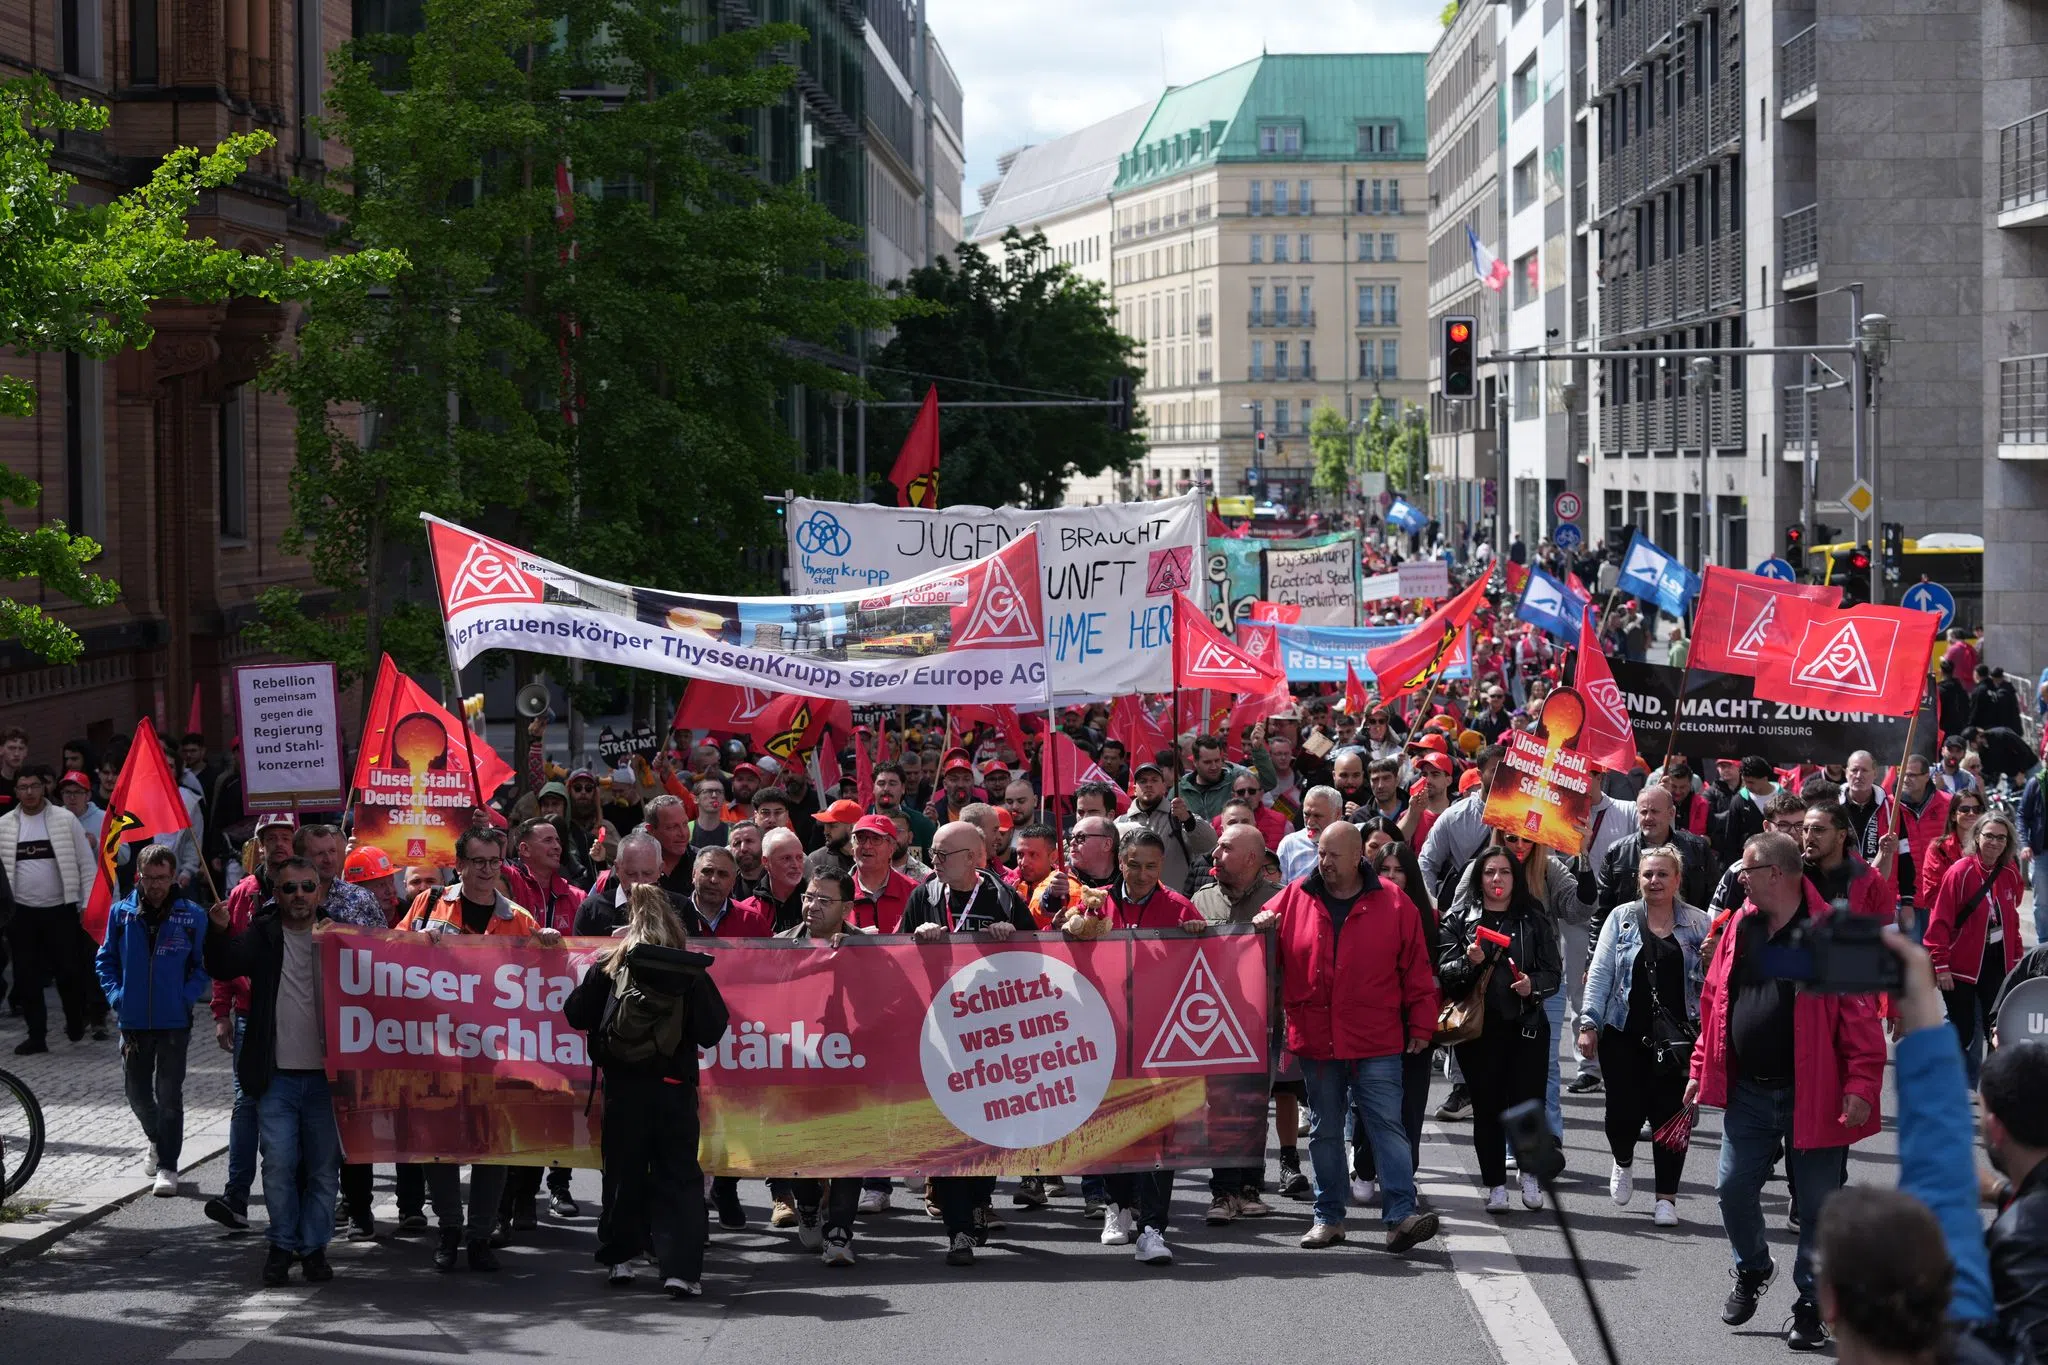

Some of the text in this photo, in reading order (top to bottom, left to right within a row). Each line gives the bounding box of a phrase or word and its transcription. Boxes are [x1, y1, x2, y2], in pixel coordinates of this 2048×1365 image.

[1561, 500, 1576, 514] 30
[896, 519, 1170, 561] JUGEN BRAUCHT
[1047, 561, 1137, 599] UNFT
[1270, 568, 1325, 588] Electrical
[1049, 612, 1107, 664] HME
[450, 618, 1046, 690] Vertrauenskörper ThyssenKrupp Steel Europe AG
[1288, 649, 1371, 670] Rassel
[252, 675, 315, 690] Rebellion
[253, 692, 317, 706] gemeinsam
[1674, 698, 1769, 720] MACHT.
[260, 707, 313, 722] gegen die
[254, 724, 323, 739] Regierung
[1631, 718, 1813, 737] GEND ACELORMITTAL DUISBURG
[256, 739, 324, 754] und Stahl-
[1516, 732, 1587, 775] Unser Stahl.
[258, 757, 325, 771] konzerne!
[1506, 750, 1588, 795] Deutschlands
[370, 770, 466, 789] Unser Stahl.
[364, 789, 472, 808] Deutschlands
[1518, 776, 1562, 806] Stärke.
[388, 809, 446, 826] Stärke.
[1866, 814, 1879, 854] ERTRAUENS
[339, 948, 482, 1004] Unser
[948, 971, 1064, 1018] Schützt,
[958, 1008, 1070, 1054] was uns
[2027, 1012, 2048, 1034] U
[946, 1036, 1099, 1093] erfolgreich
[982, 1075, 1077, 1122] macht!
